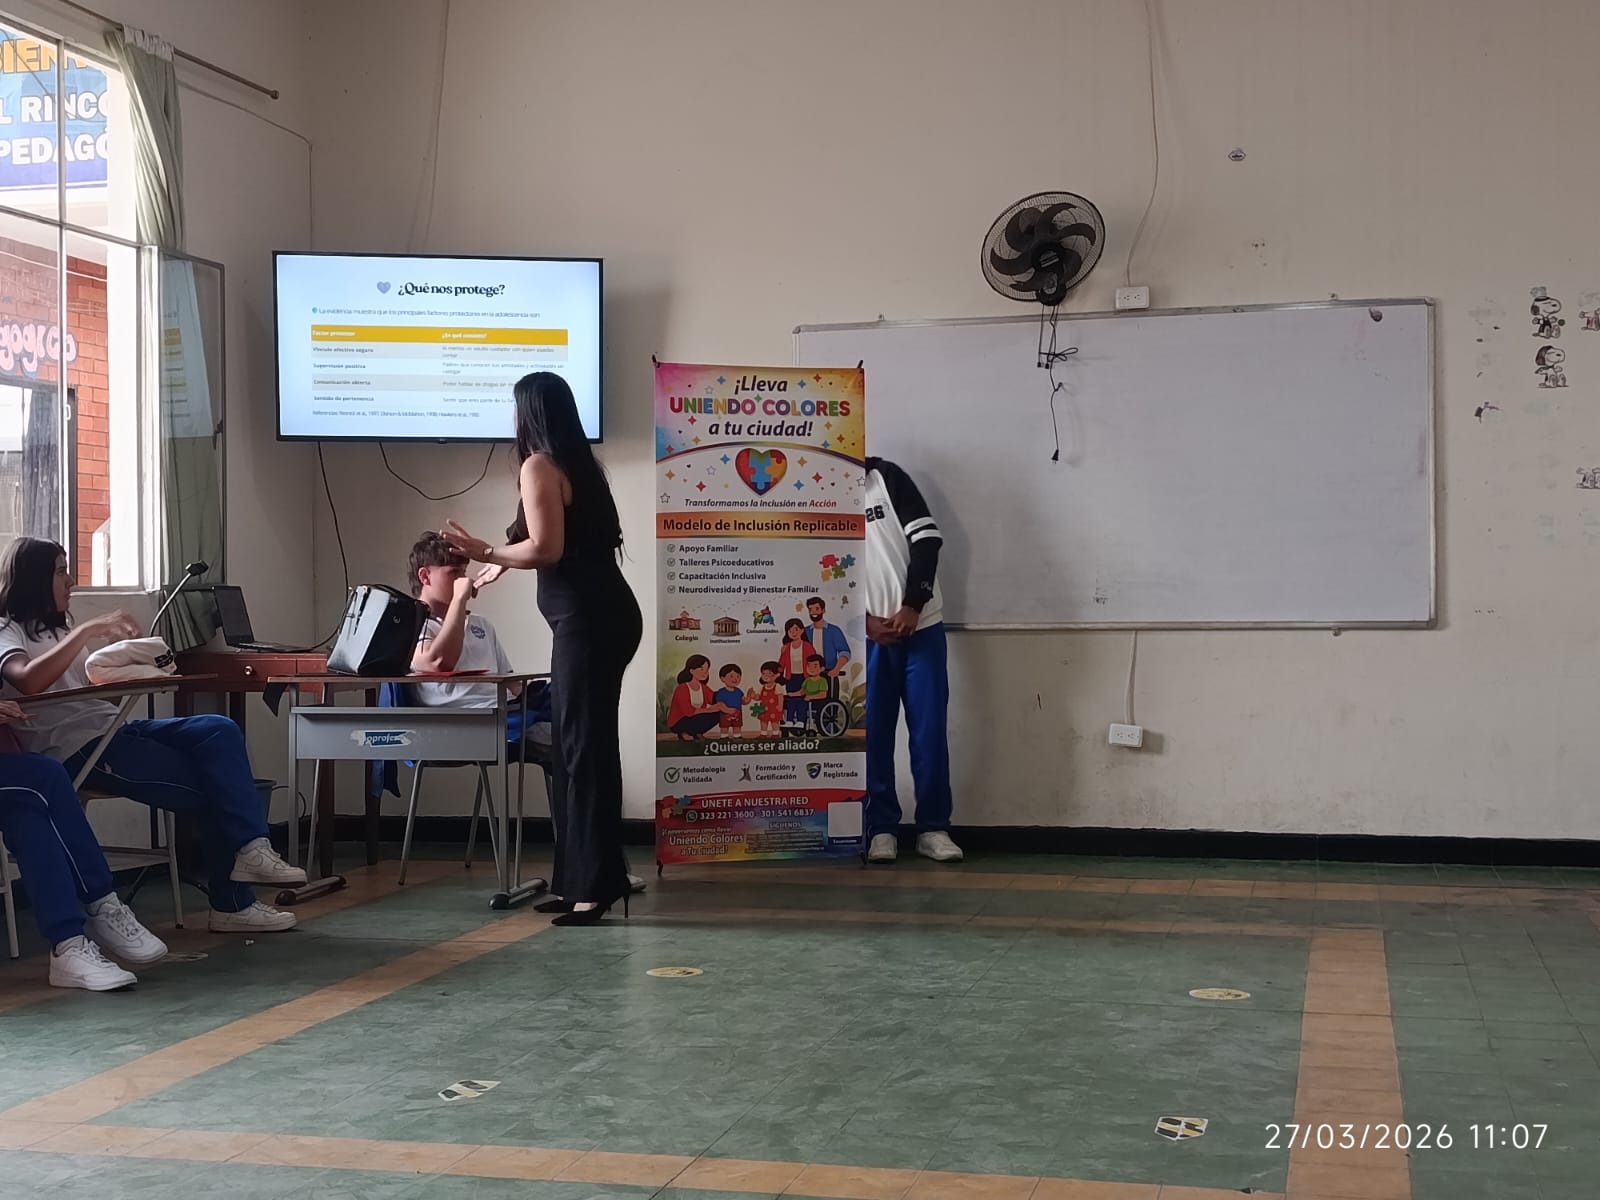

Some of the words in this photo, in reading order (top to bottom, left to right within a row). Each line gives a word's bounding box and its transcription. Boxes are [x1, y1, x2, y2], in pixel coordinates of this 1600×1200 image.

[398, 282, 430, 296] ¿Qué
[431, 284, 453, 295] nos
[454, 284, 505, 298] protege?
[734, 375, 788, 395] ¡Lleva
[670, 397, 756, 416] UNIENDO
[762, 399, 850, 417] COLORES
[708, 423, 720, 435] a
[724, 421, 743, 436] tu
[747, 420, 814, 437] ciudad!
[685, 499, 749, 508] Transformamos
[750, 499, 759, 508] la
[809, 498, 837, 508] Acción
[663, 519, 712, 531] Modelo
[714, 519, 731, 531] de
[733, 519, 791, 532] Inclusión
[793, 520, 858, 533] Replicable
[679, 545, 706, 554] Apoyo
[706, 545, 739, 553] Familiar
[679, 558, 710, 567] Talleres
[711, 558, 774, 567] Psicoeducativos
[678, 572, 730, 581] Capacitación
[731, 572, 767, 581] Inclusiva
[678, 585, 742, 594] Neurodivesidad
[743, 587, 748, 595] y
[749, 585, 787, 594] Bienestar
[787, 585, 819, 594] Familiar
[675, 634, 699, 643] Colegio
[703, 741, 755, 755] ¿Quieres
[757, 742, 775, 752] ser
[778, 740, 820, 751] aliado?
[683, 766, 726, 775] Metodología
[755, 764, 791, 772] Formación
[791, 765, 796, 773] y
[683, 776, 713, 784] Validada
[755, 773, 797, 782] Certificación
[823, 771, 858, 779] Registrada
[735, 799, 742, 808] A
[744, 797, 788, 807] NUESTRA
[790, 796, 809, 806] RED
[700, 811, 715, 820] 323
[716, 811, 732, 820] 221
[734, 810, 755, 819] 3600
[761, 810, 776, 818] 301
[777, 809, 793, 818] 541
[793, 808, 814, 817] 6837
[669, 835, 708, 846] Uniendo
[710, 833, 744, 844] Colores
